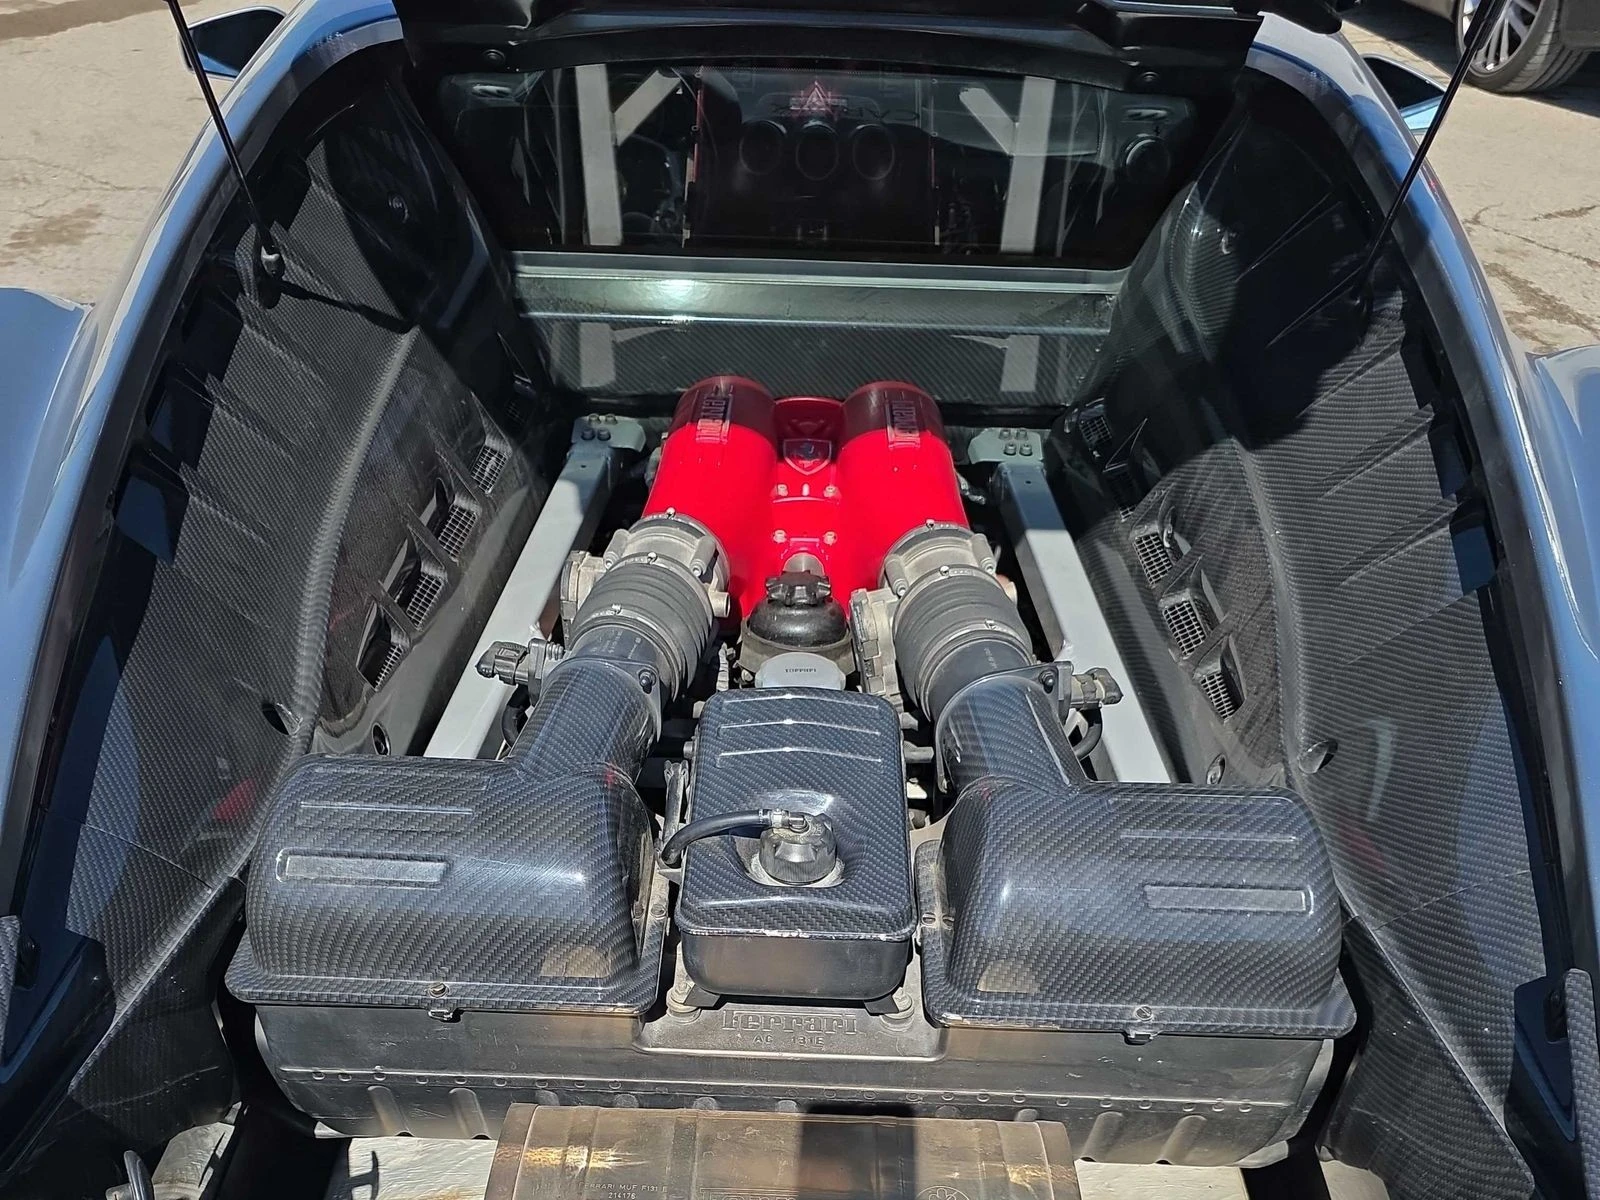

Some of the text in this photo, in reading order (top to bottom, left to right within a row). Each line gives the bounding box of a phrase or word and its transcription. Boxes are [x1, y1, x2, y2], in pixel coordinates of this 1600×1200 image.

[722, 1009, 857, 1035] Ferrari
[619, 1183, 638, 1191] MUF
[641, 1184, 658, 1192] F131
